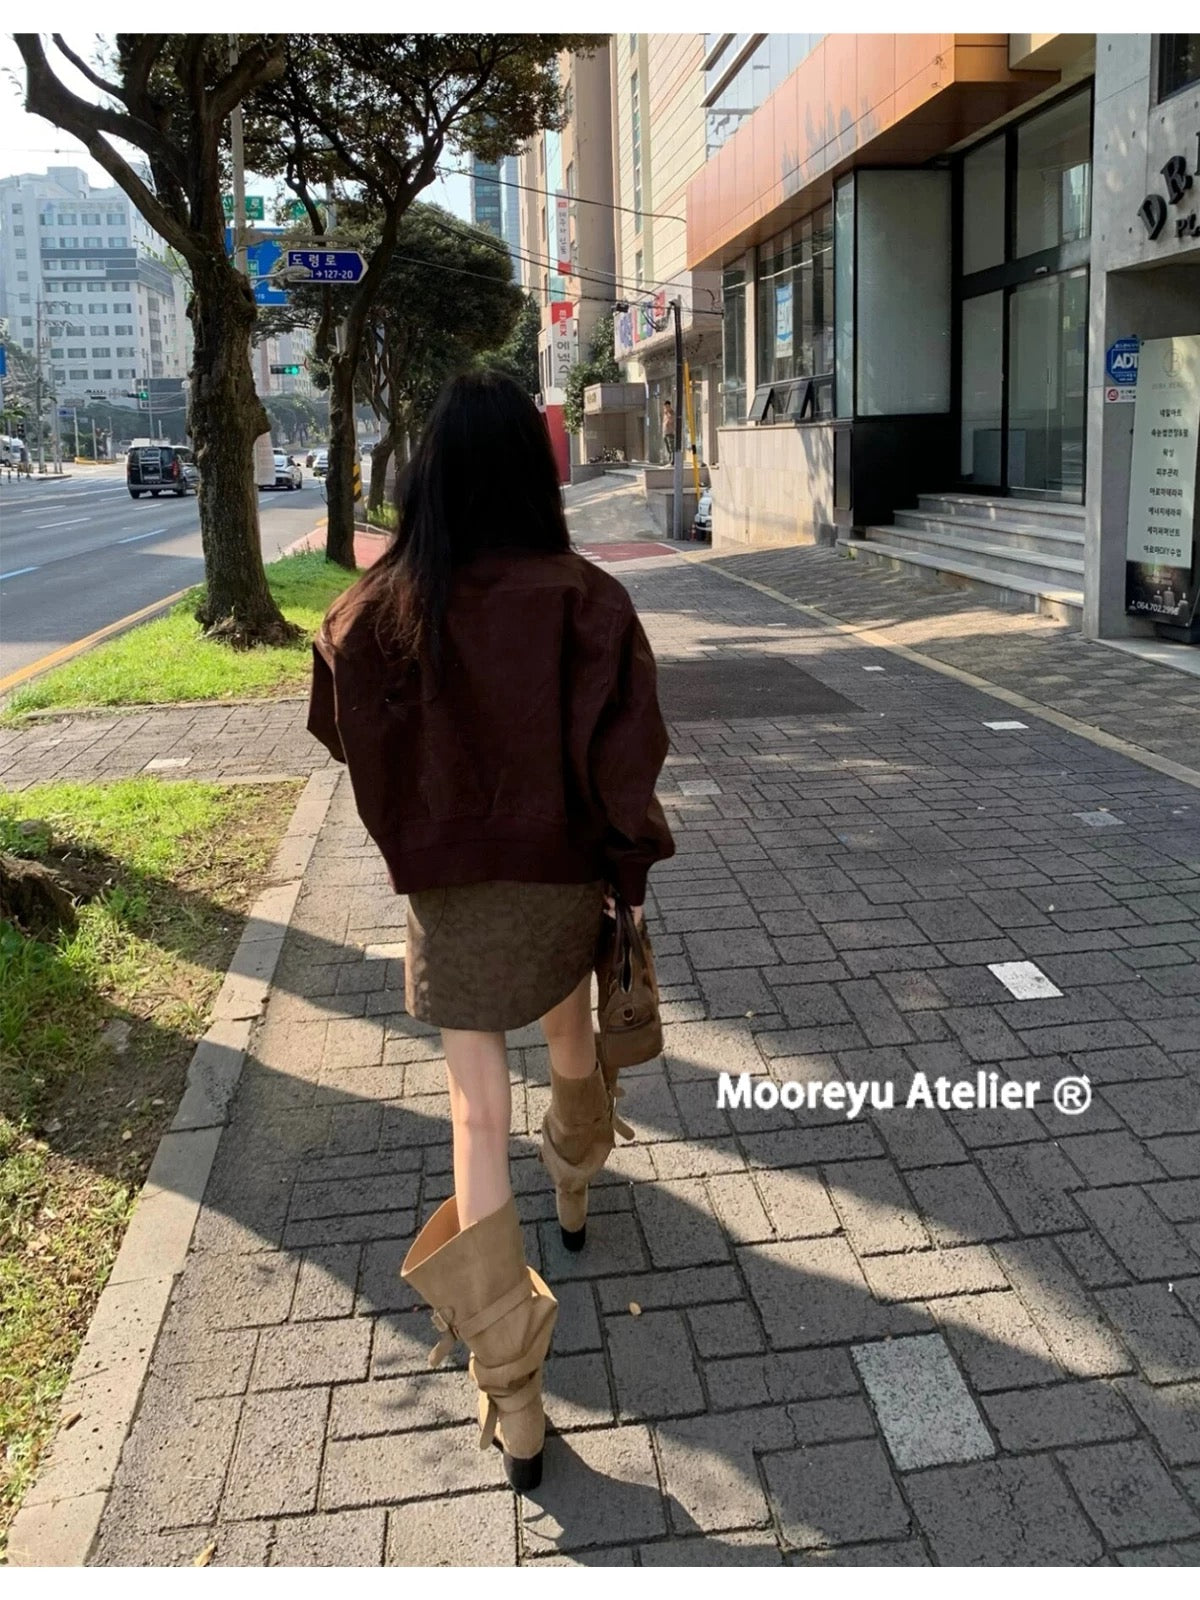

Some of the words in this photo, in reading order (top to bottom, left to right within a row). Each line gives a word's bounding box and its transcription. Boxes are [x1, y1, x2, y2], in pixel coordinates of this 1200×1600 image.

[1137, 132, 1200, 240] DR
[292, 254, 337, 268] 도령로
[324, 270, 354, 279] 127-20
[1112, 352, 1139, 369] ADT
